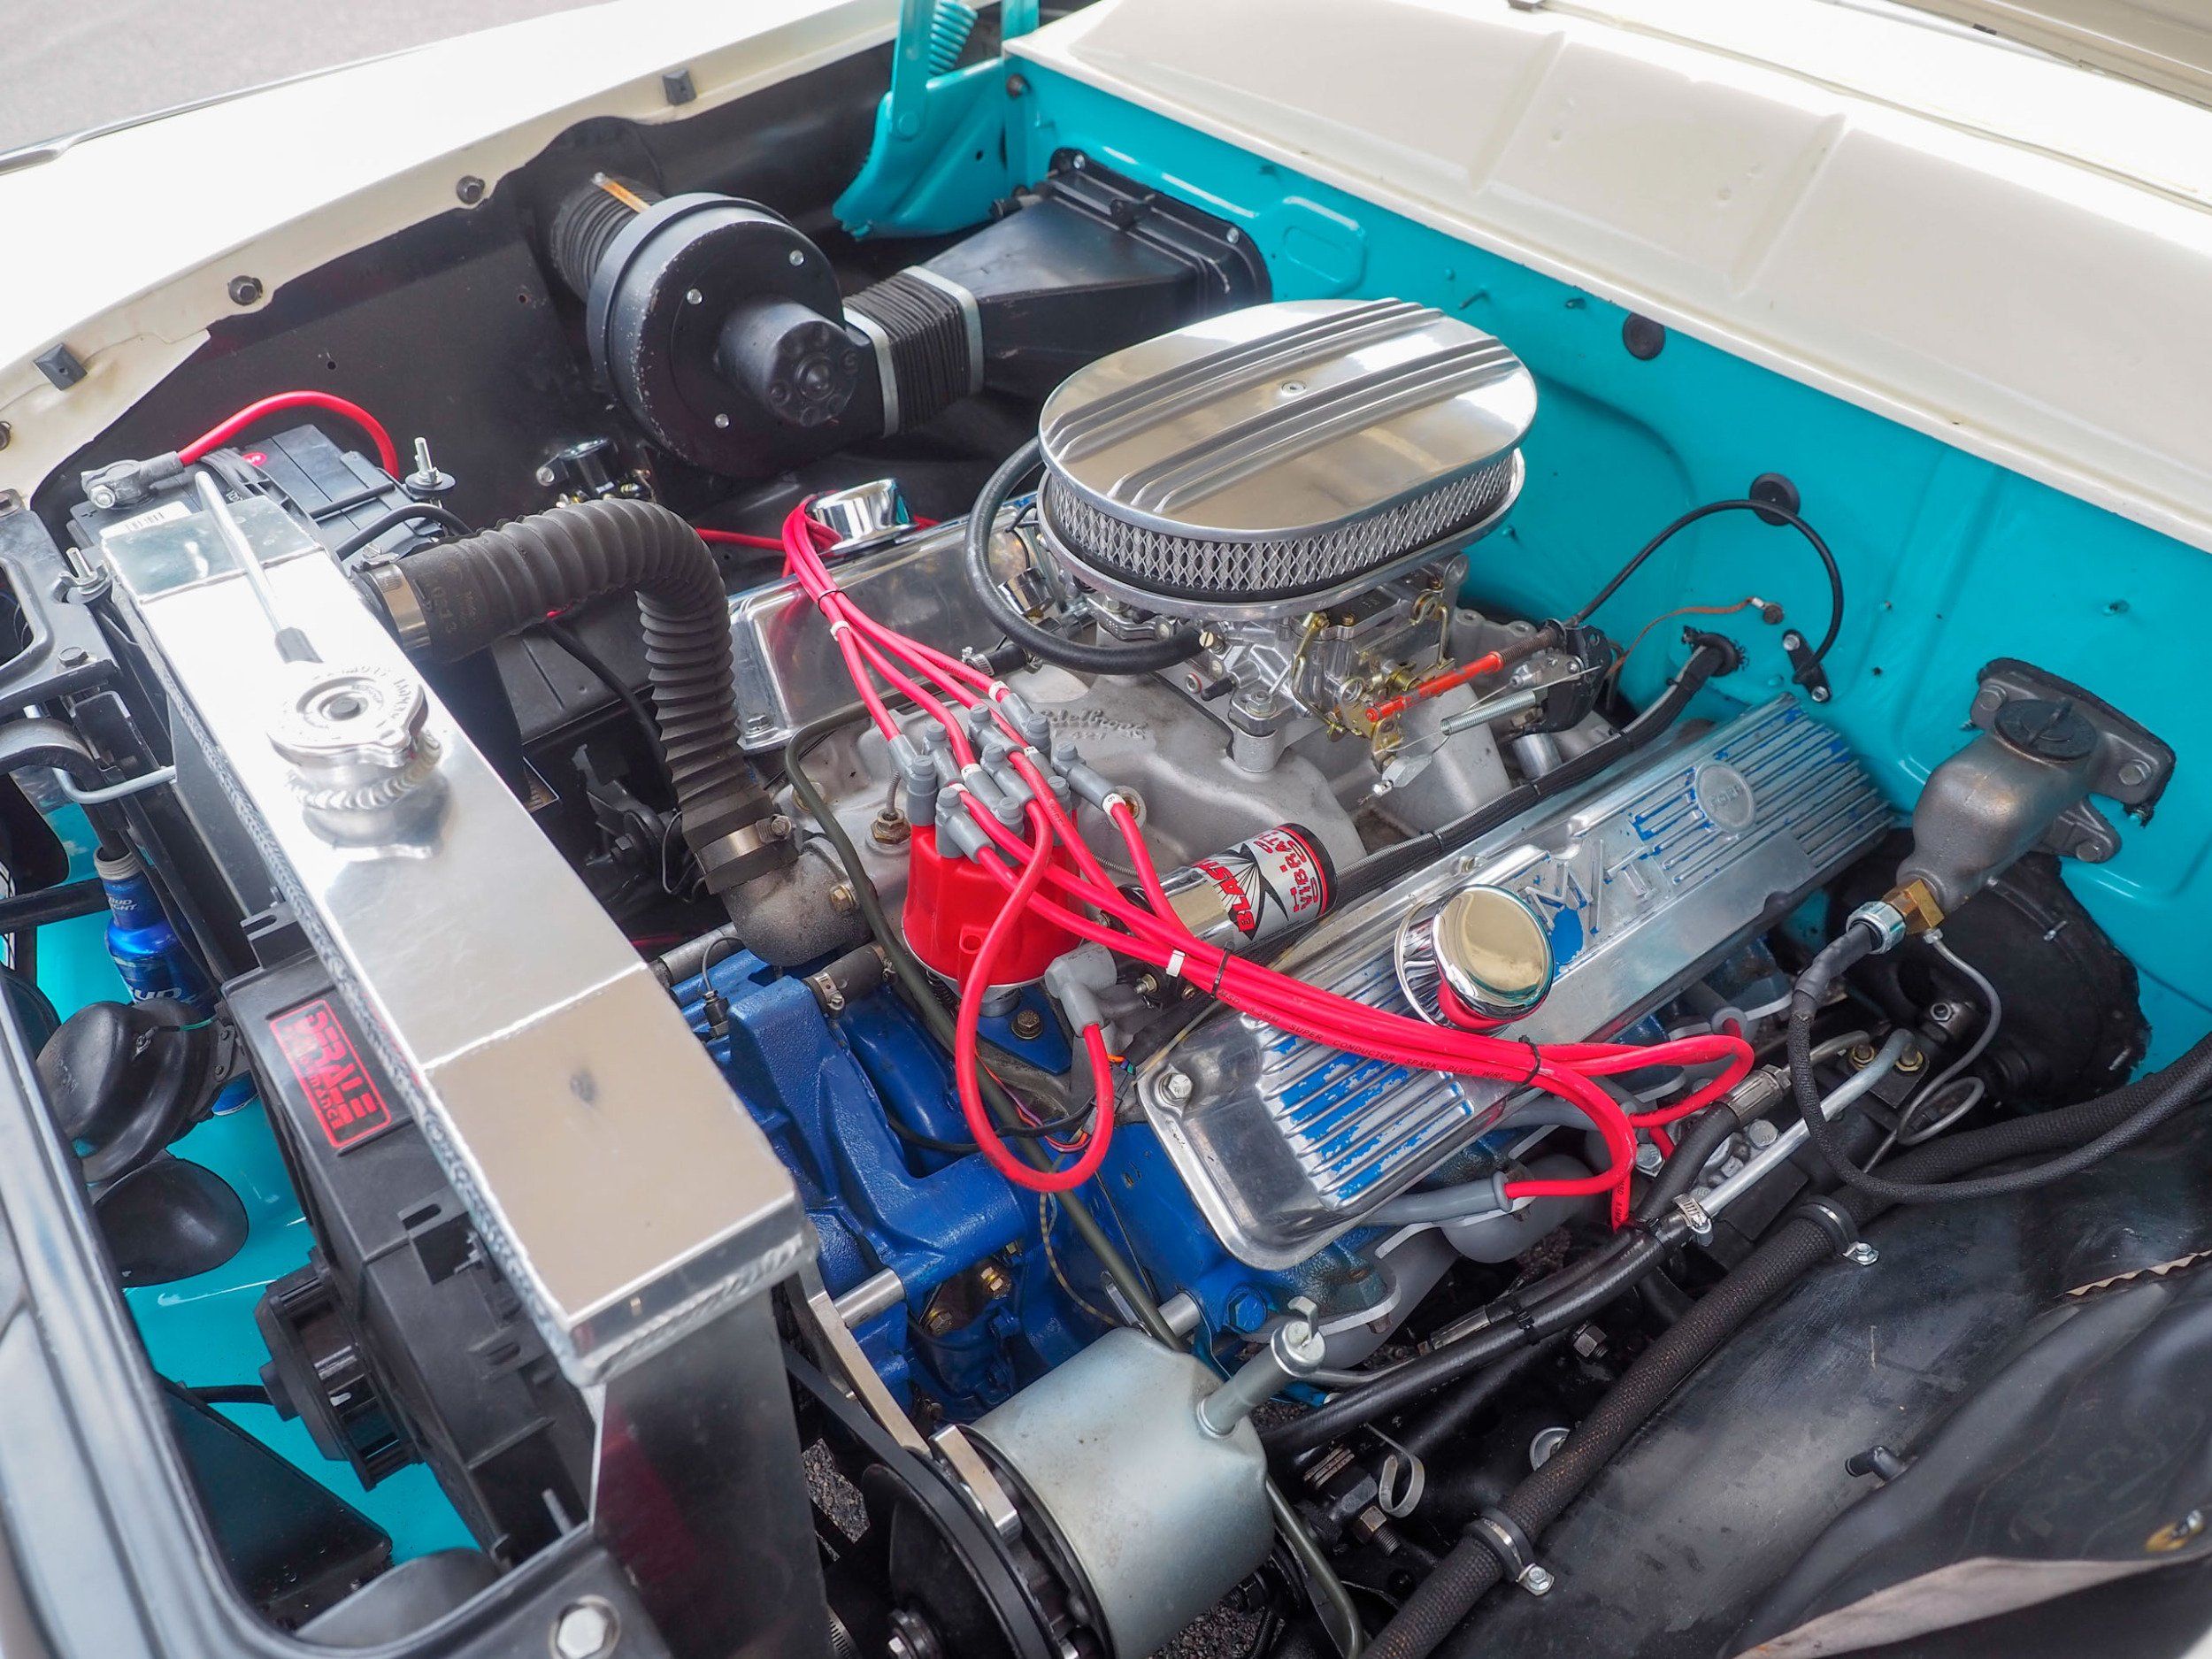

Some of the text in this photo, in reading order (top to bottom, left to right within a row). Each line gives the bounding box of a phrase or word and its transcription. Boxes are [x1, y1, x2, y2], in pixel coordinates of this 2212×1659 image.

[1218, 989, 1240, 1004] MSD
[1287, 1022, 1325, 1041] SUPER
[1332, 1039, 1396, 1061] CONDUCTOR
[1404, 1056, 1439, 1070] SPARK
[1446, 1064, 1473, 1075] PLUG
